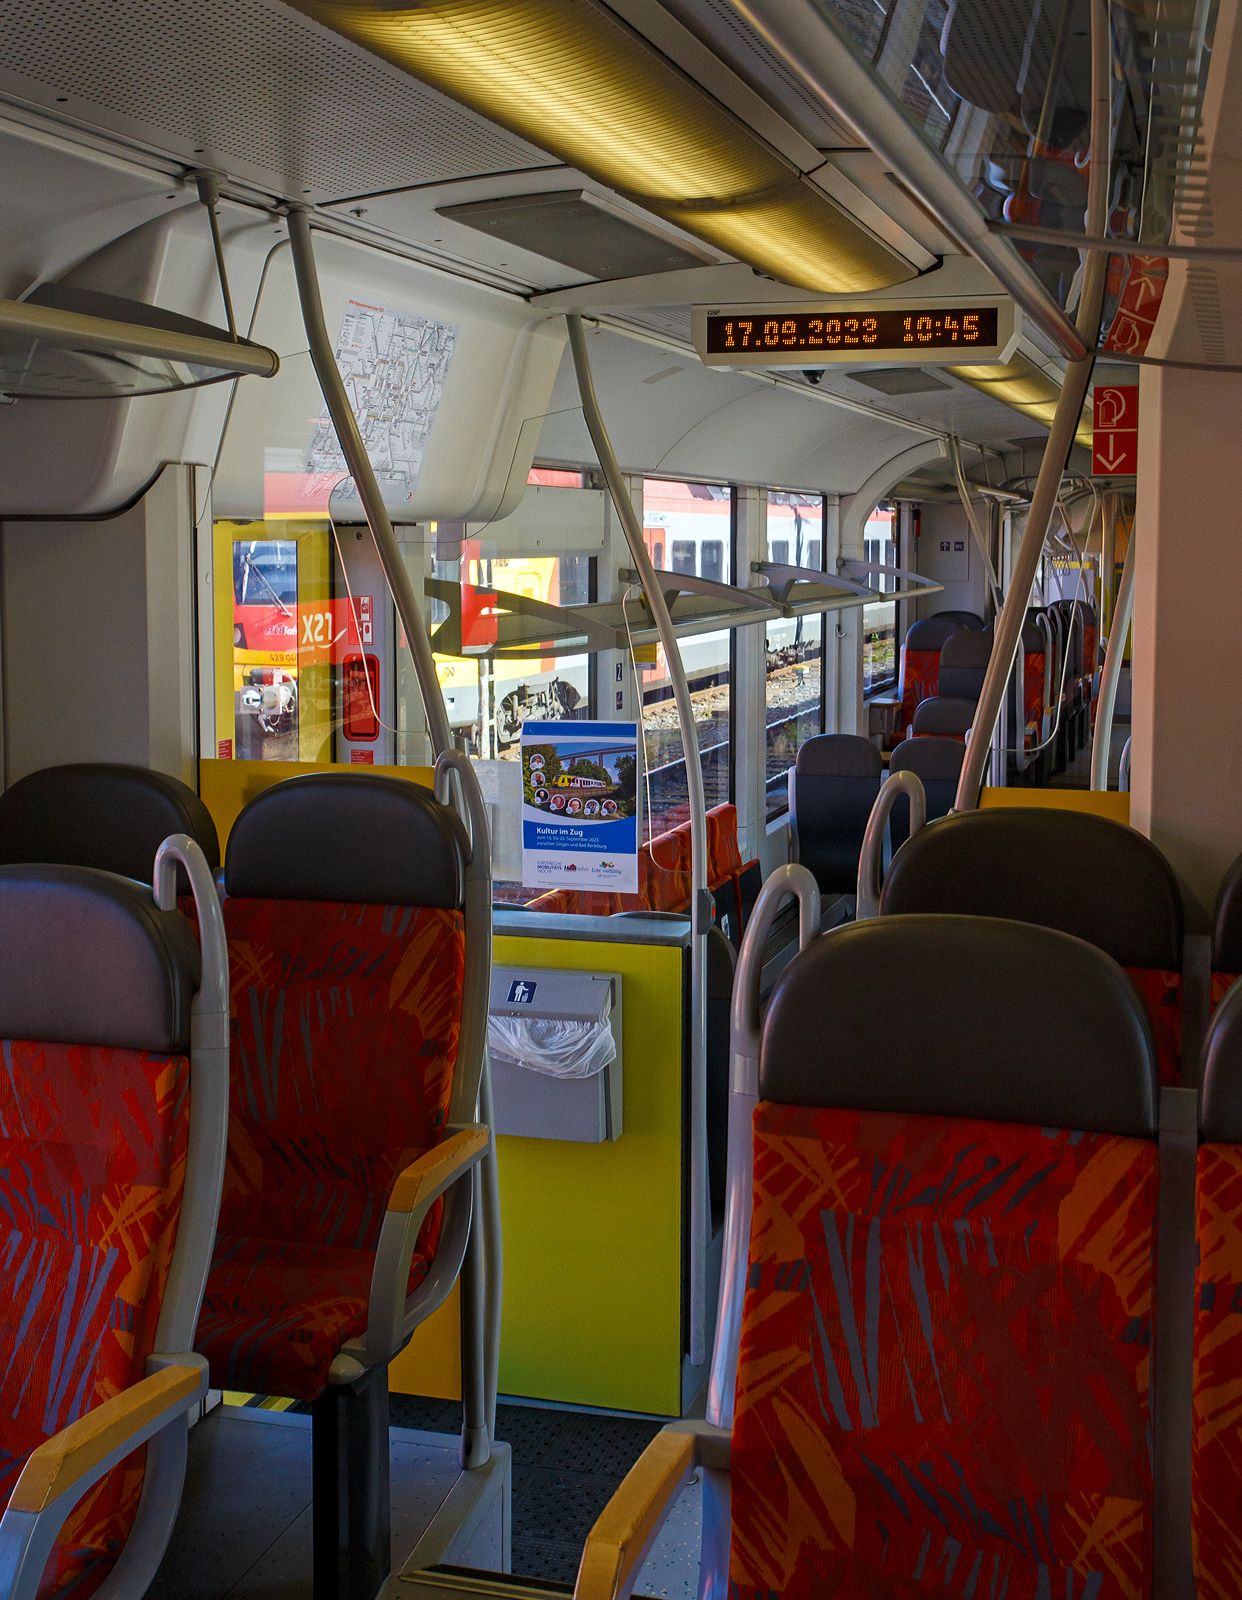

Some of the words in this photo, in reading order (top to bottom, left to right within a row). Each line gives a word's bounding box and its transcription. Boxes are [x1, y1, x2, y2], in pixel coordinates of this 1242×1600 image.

[725, 319, 877, 347] 17.09.2023
[903, 315, 980, 342] 10:45
[616, 664, 622, 681] 2
[569, 828, 583, 837] Zug
